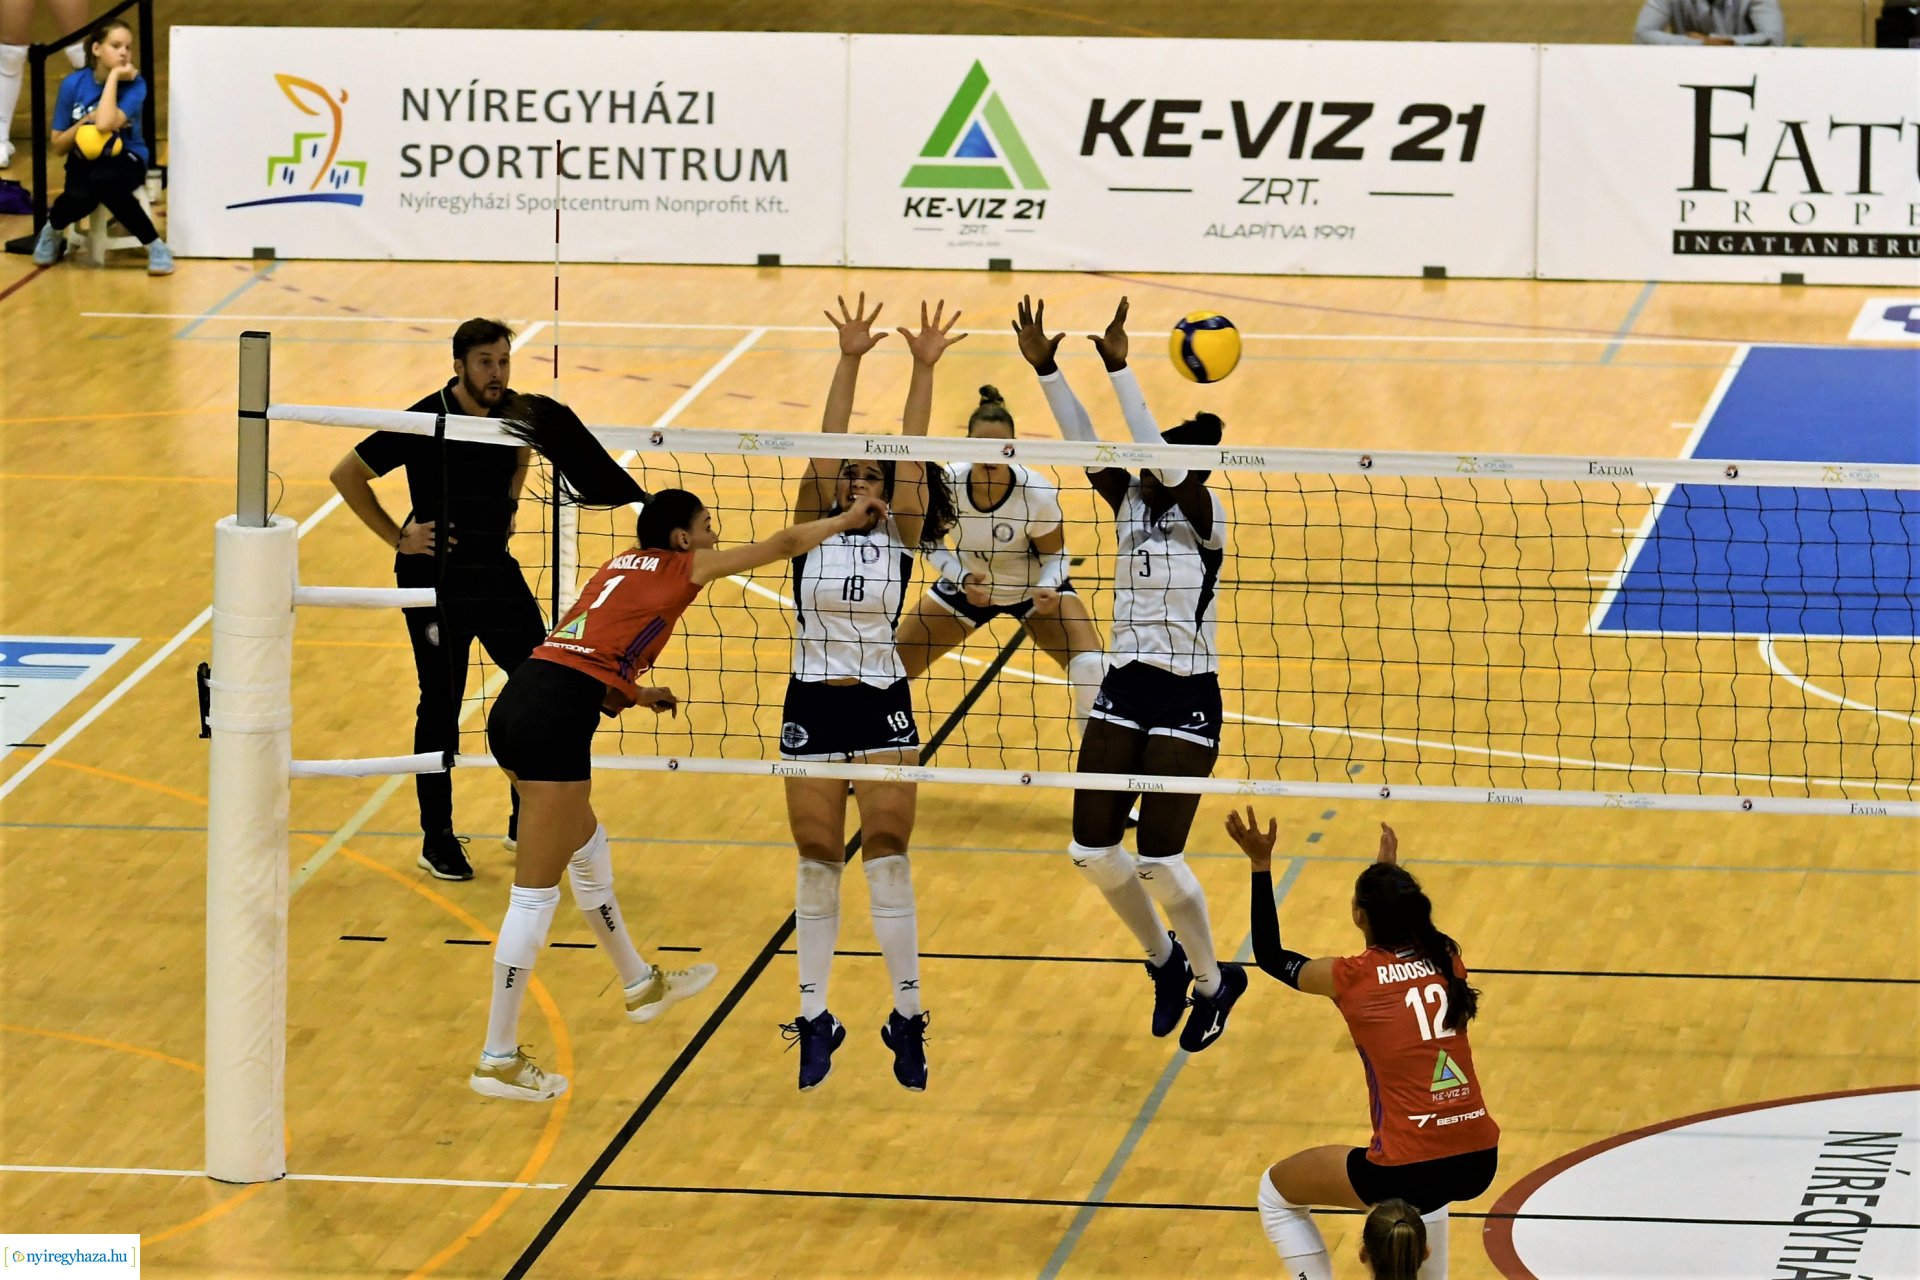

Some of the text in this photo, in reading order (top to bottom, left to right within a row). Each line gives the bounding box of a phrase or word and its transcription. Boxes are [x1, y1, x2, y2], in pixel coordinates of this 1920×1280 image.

[402, 79, 714, 124] NYÍREGYHÁZI
[1080, 98, 1485, 162] KE-VIZ 21
[399, 144, 788, 182] SPORTCENTRUM
[400, 191, 789, 216] Nyíregyházi Sportcentrum Nonprofit Kft.
[1237, 177, 1319, 205] ZRT.
[903, 196, 1046, 219] KE-VIZ 21
[1203, 220, 1356, 240] ALAPÍTVA 1991
[1137, 549, 1152, 578] 3
[588, 574, 626, 610] 1
[842, 574, 865, 602] 18
[886, 710, 910, 732] 18
[1376, 958, 1443, 985] RADOSO
[1404, 983, 1457, 1042] 12
[1432, 1088, 1461, 1102] KE-VIZ
